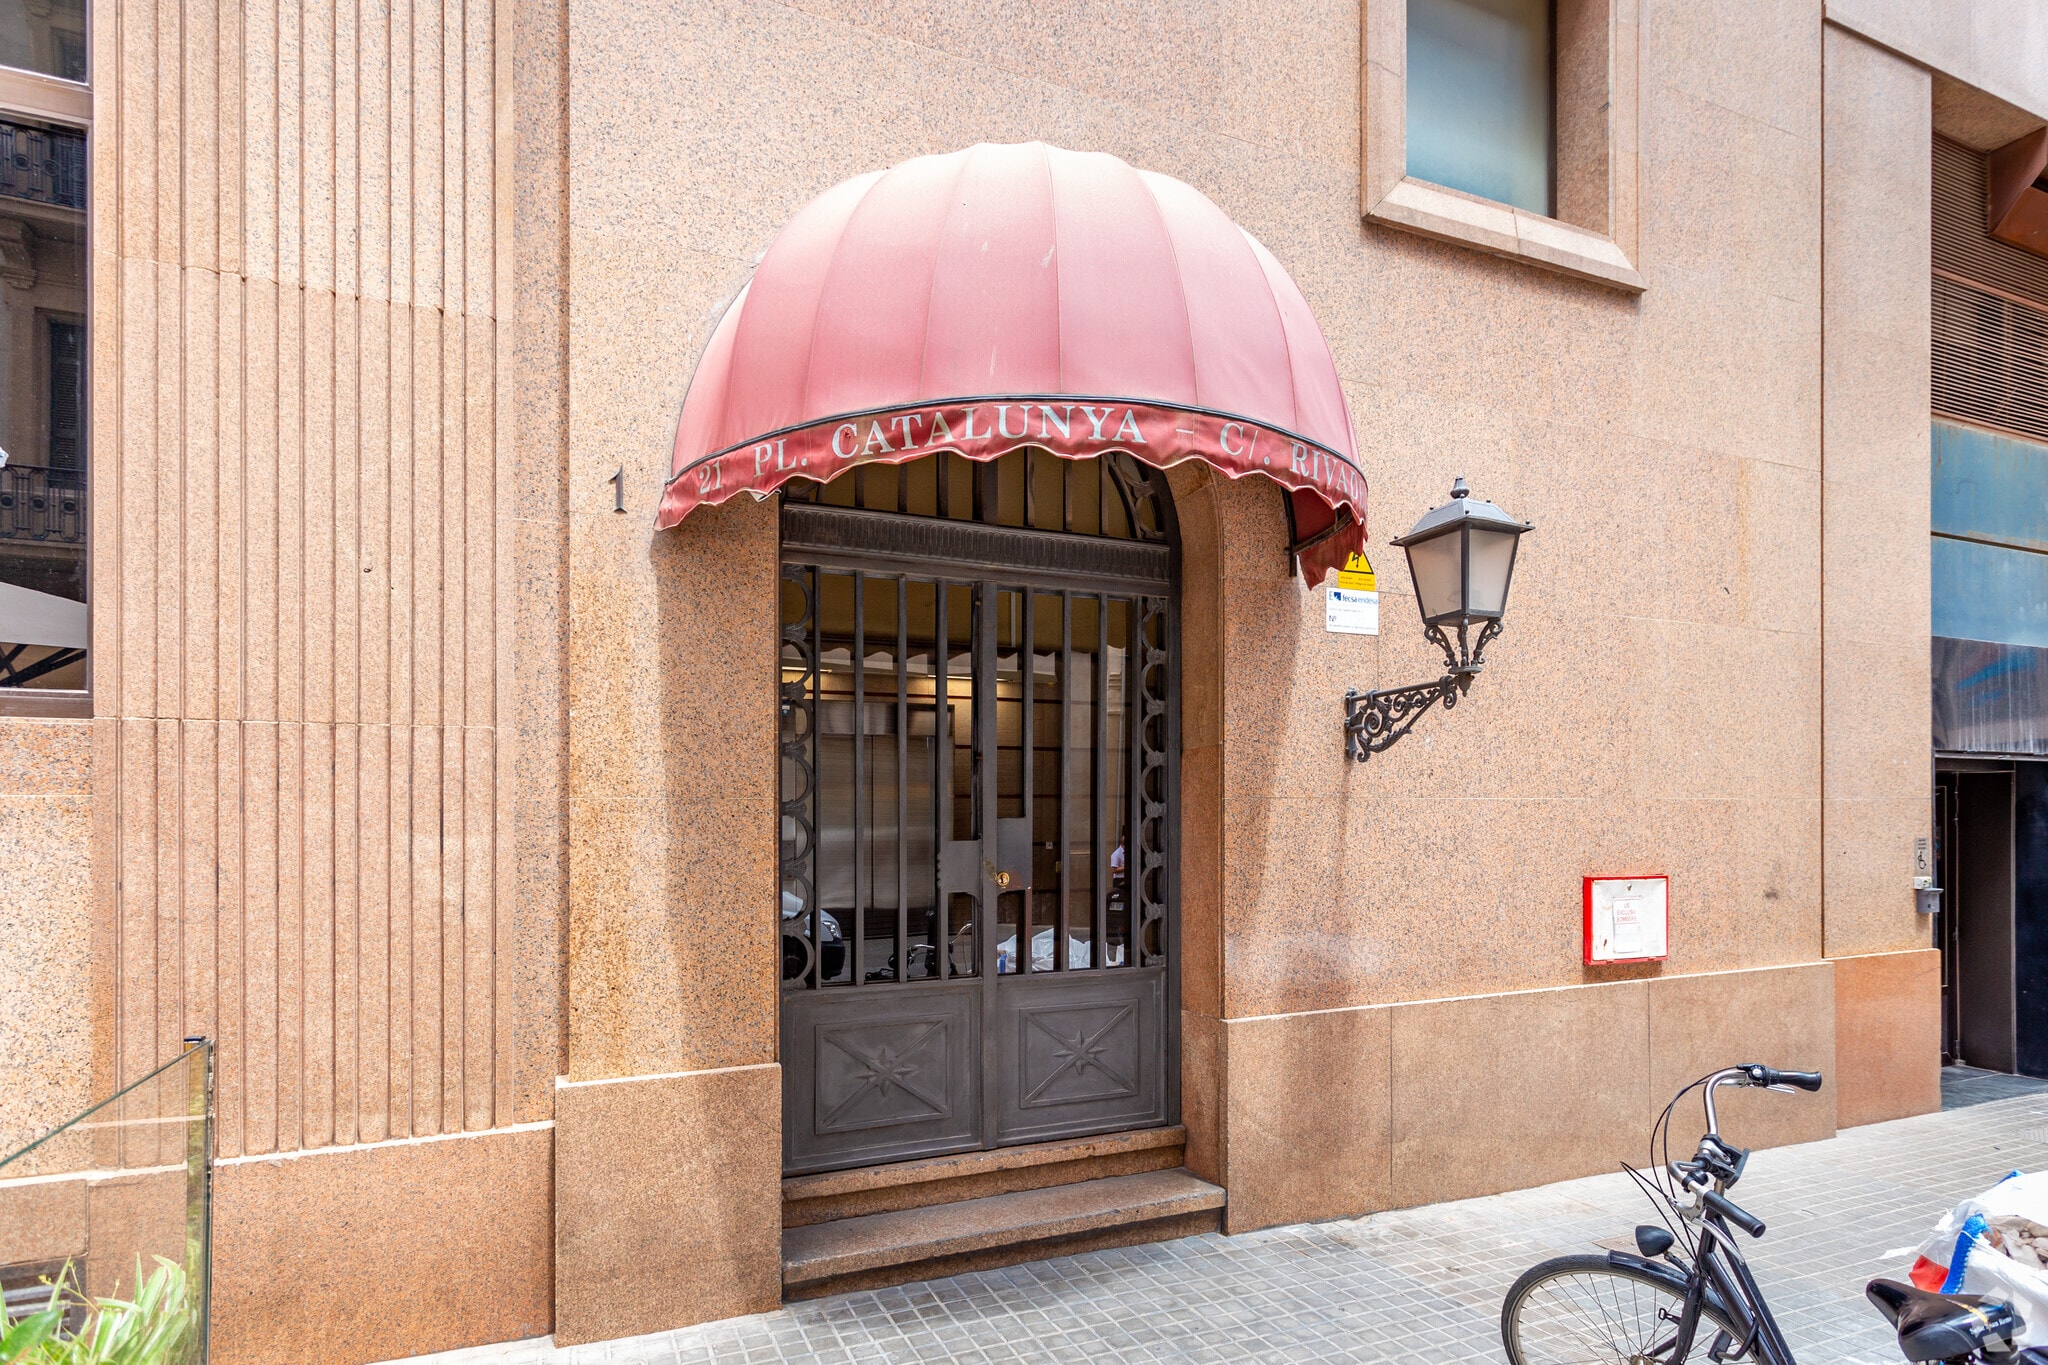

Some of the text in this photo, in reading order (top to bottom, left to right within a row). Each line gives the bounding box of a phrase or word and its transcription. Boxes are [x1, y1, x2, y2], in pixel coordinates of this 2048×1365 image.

[699, 461, 723, 494] 21
[753, 438, 807, 478] PL.
[832, 404, 1147, 459] CATALUNYA
[608, 463, 628, 514] 1
